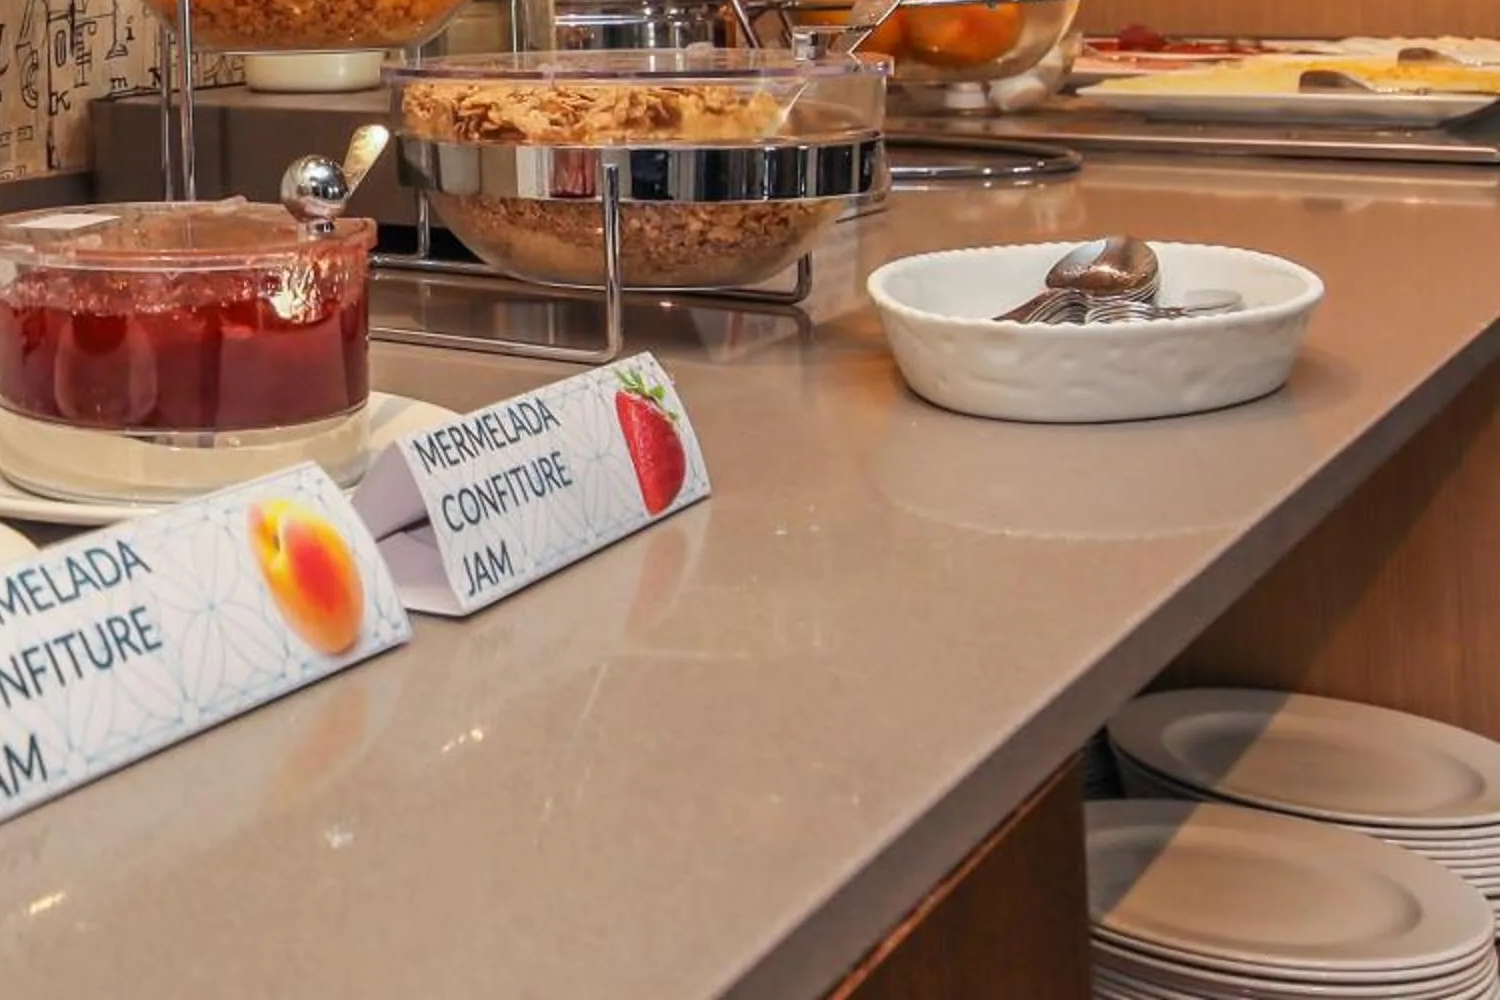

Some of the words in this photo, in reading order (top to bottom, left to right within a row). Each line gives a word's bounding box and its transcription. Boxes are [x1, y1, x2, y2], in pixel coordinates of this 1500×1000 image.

[411, 396, 562, 475] MERMELADA
[442, 451, 574, 533] CONFITURE
[462, 540, 515, 598] JAM
